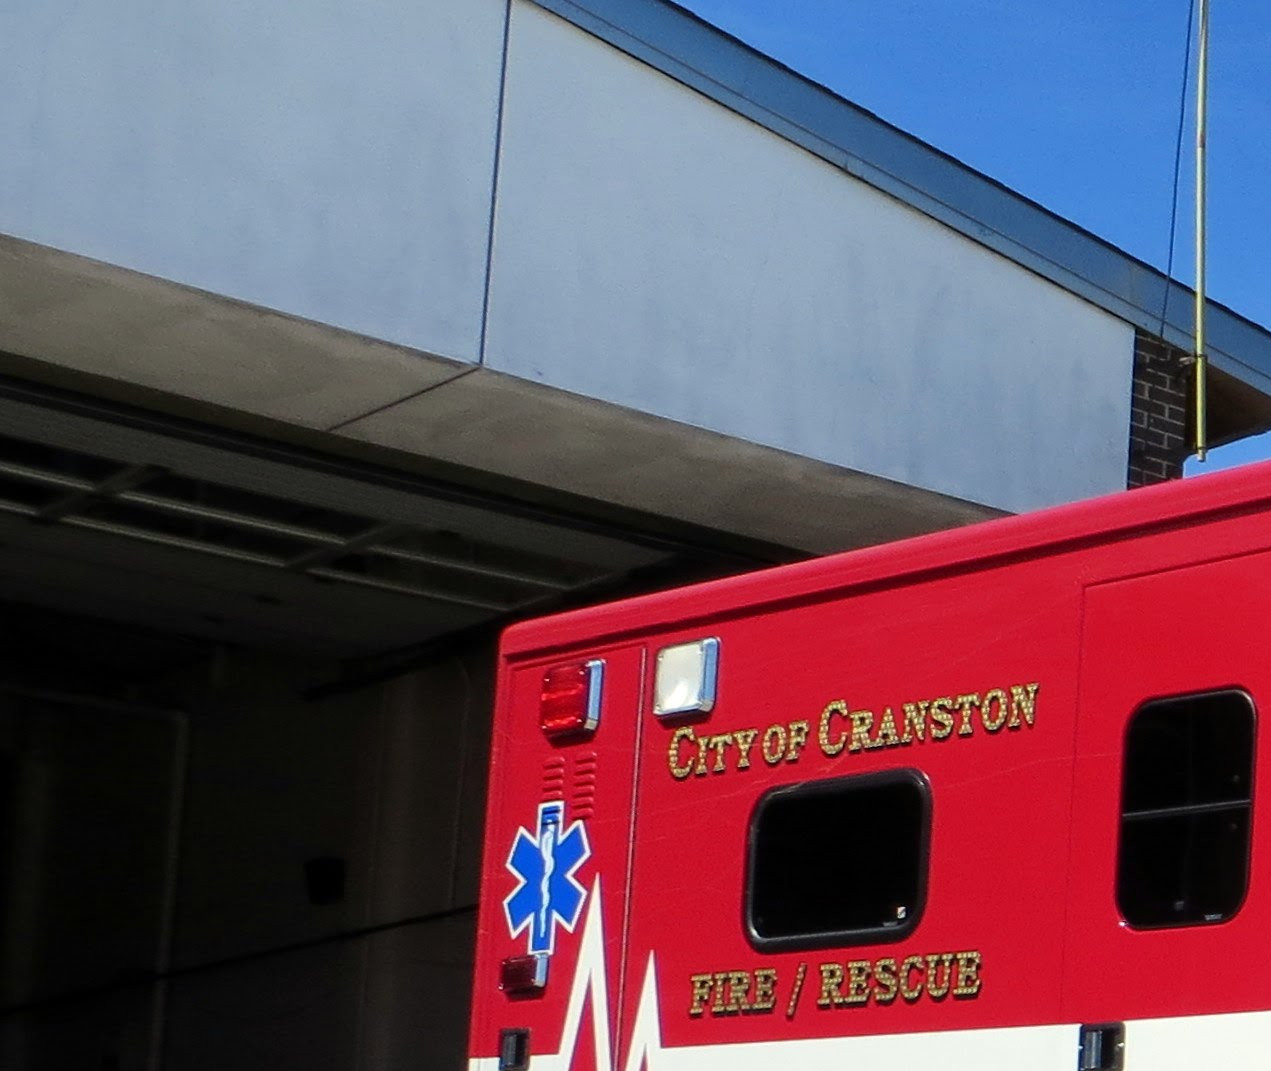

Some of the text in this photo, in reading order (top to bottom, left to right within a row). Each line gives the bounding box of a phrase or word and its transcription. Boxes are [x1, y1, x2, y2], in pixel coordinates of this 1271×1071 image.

[818, 682, 1041, 757] CRANSTON
[689, 966, 778, 1016] FIRE
[818, 951, 983, 1007] RESCUE
